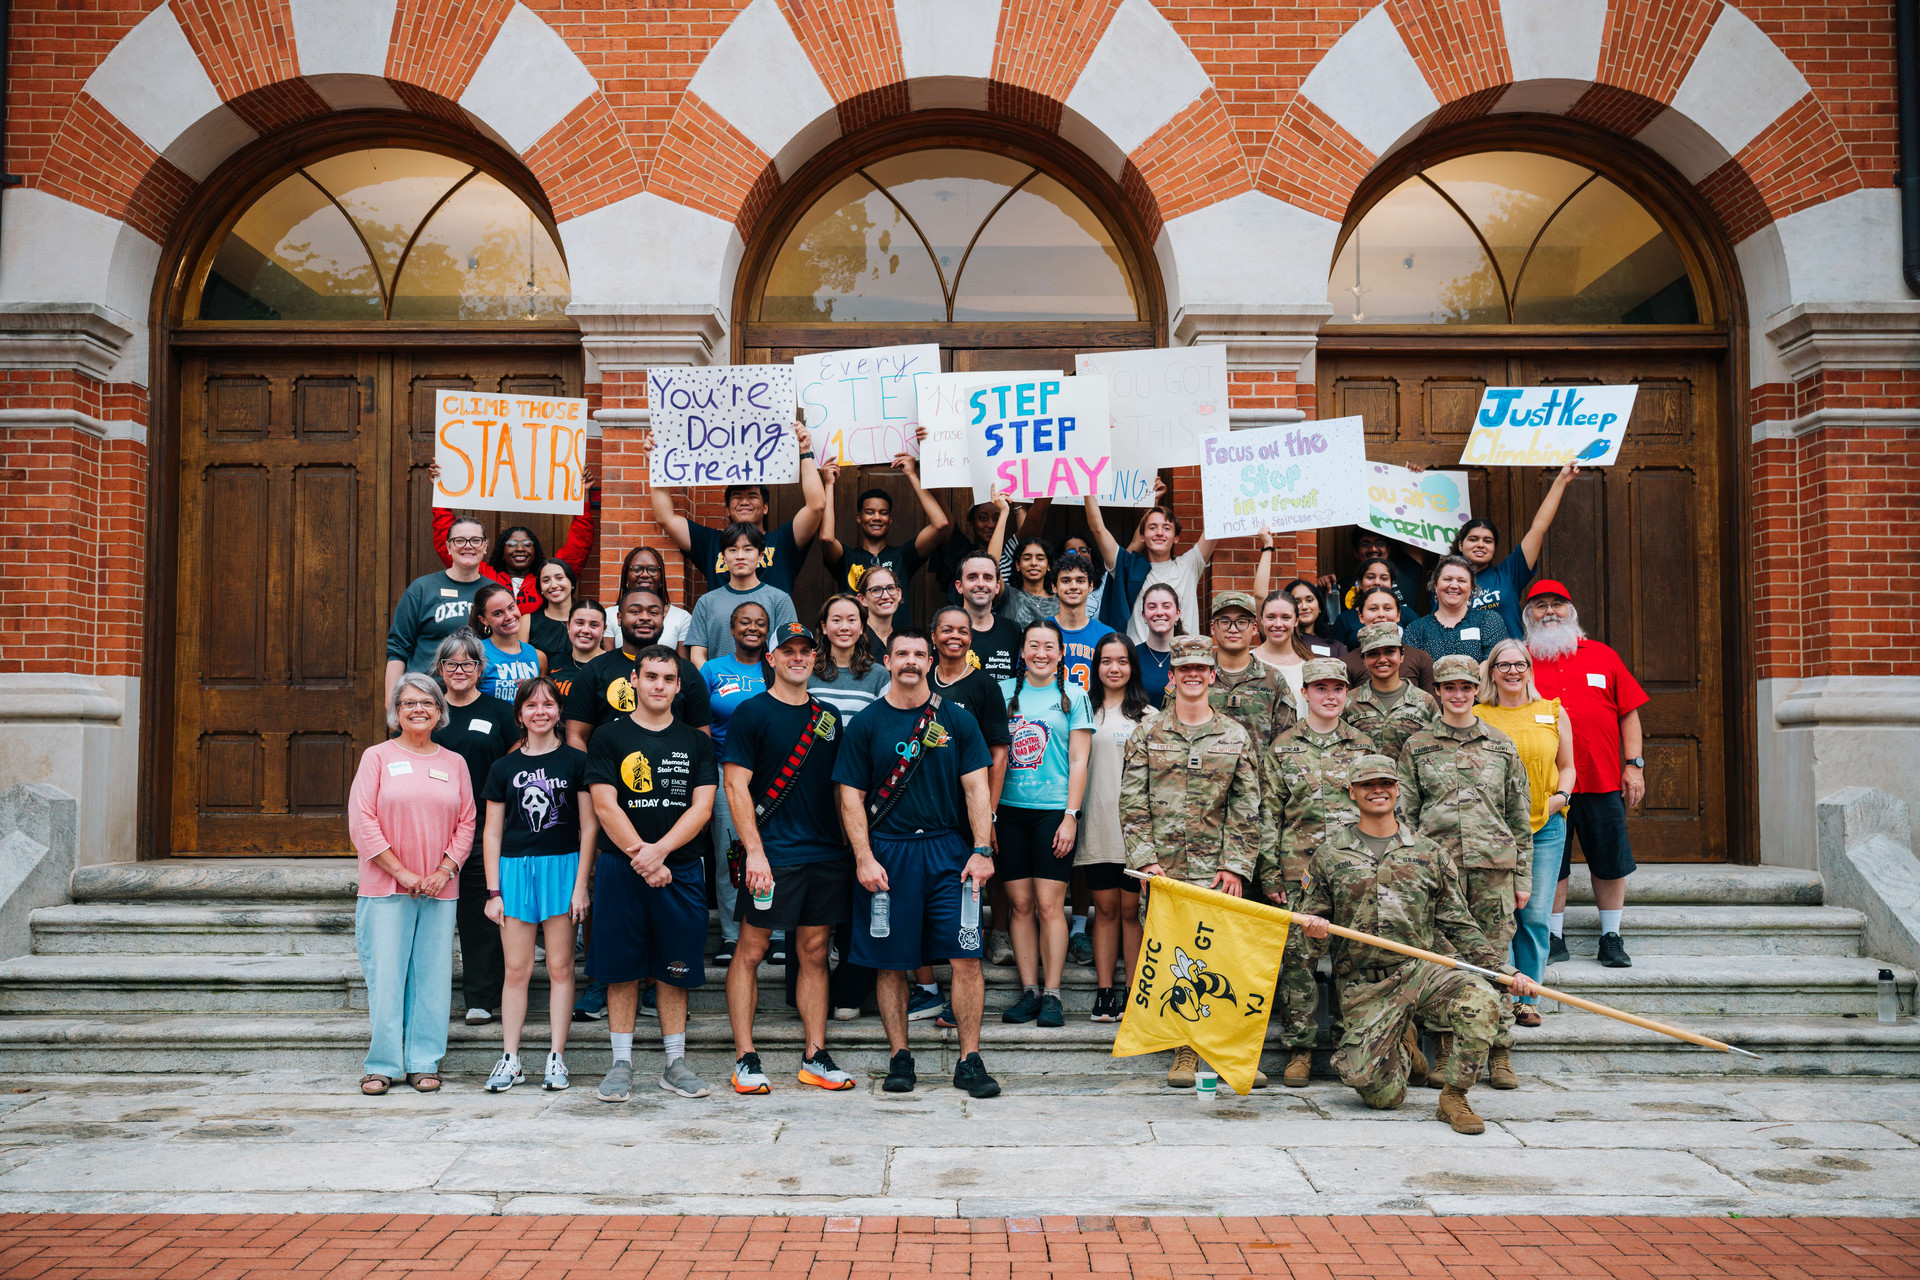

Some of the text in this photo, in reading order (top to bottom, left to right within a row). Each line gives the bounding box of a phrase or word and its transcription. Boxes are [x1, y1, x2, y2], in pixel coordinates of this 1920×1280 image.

[820, 354, 918, 383] Every
[1110, 361, 1216, 399] OU GOT
[652, 375, 771, 410] You're
[970, 381, 1060, 425] STEP
[443, 396, 580, 420] CLIMB THOSE
[1479, 388, 1617, 432] Just Keep
[688, 415, 789, 461] Doing
[810, 422, 920, 466] V1CTOR
[933, 429, 963, 442] erase
[985, 417, 1075, 457] STEP
[1125, 414, 1194, 449] THIS
[1285, 429, 1328, 457] the
[437, 419, 585, 501] STAIRS
[664, 448, 764, 483] Great!
[936, 450, 956, 468] the
[997, 456, 1110, 498] SLAY
[1240, 463, 1301, 497] Step
[1233, 497, 1255, 515] in
[1368, 486, 1448, 512] ou are
[1223, 518, 1247, 533] not
[1252, 514, 1266, 528] the
[1370, 513, 1460, 543] mazin
[1472, 590, 1500, 608] ACT
[495, 661, 539, 680] WIN
[513, 767, 547, 788] Call
[545, 777, 568, 790] me
[673, 766, 690, 774] Climb
[1194, 921, 1214, 950] GT
[1136, 938, 1162, 1009] SROTC
[1245, 993, 1264, 1016] YJ
